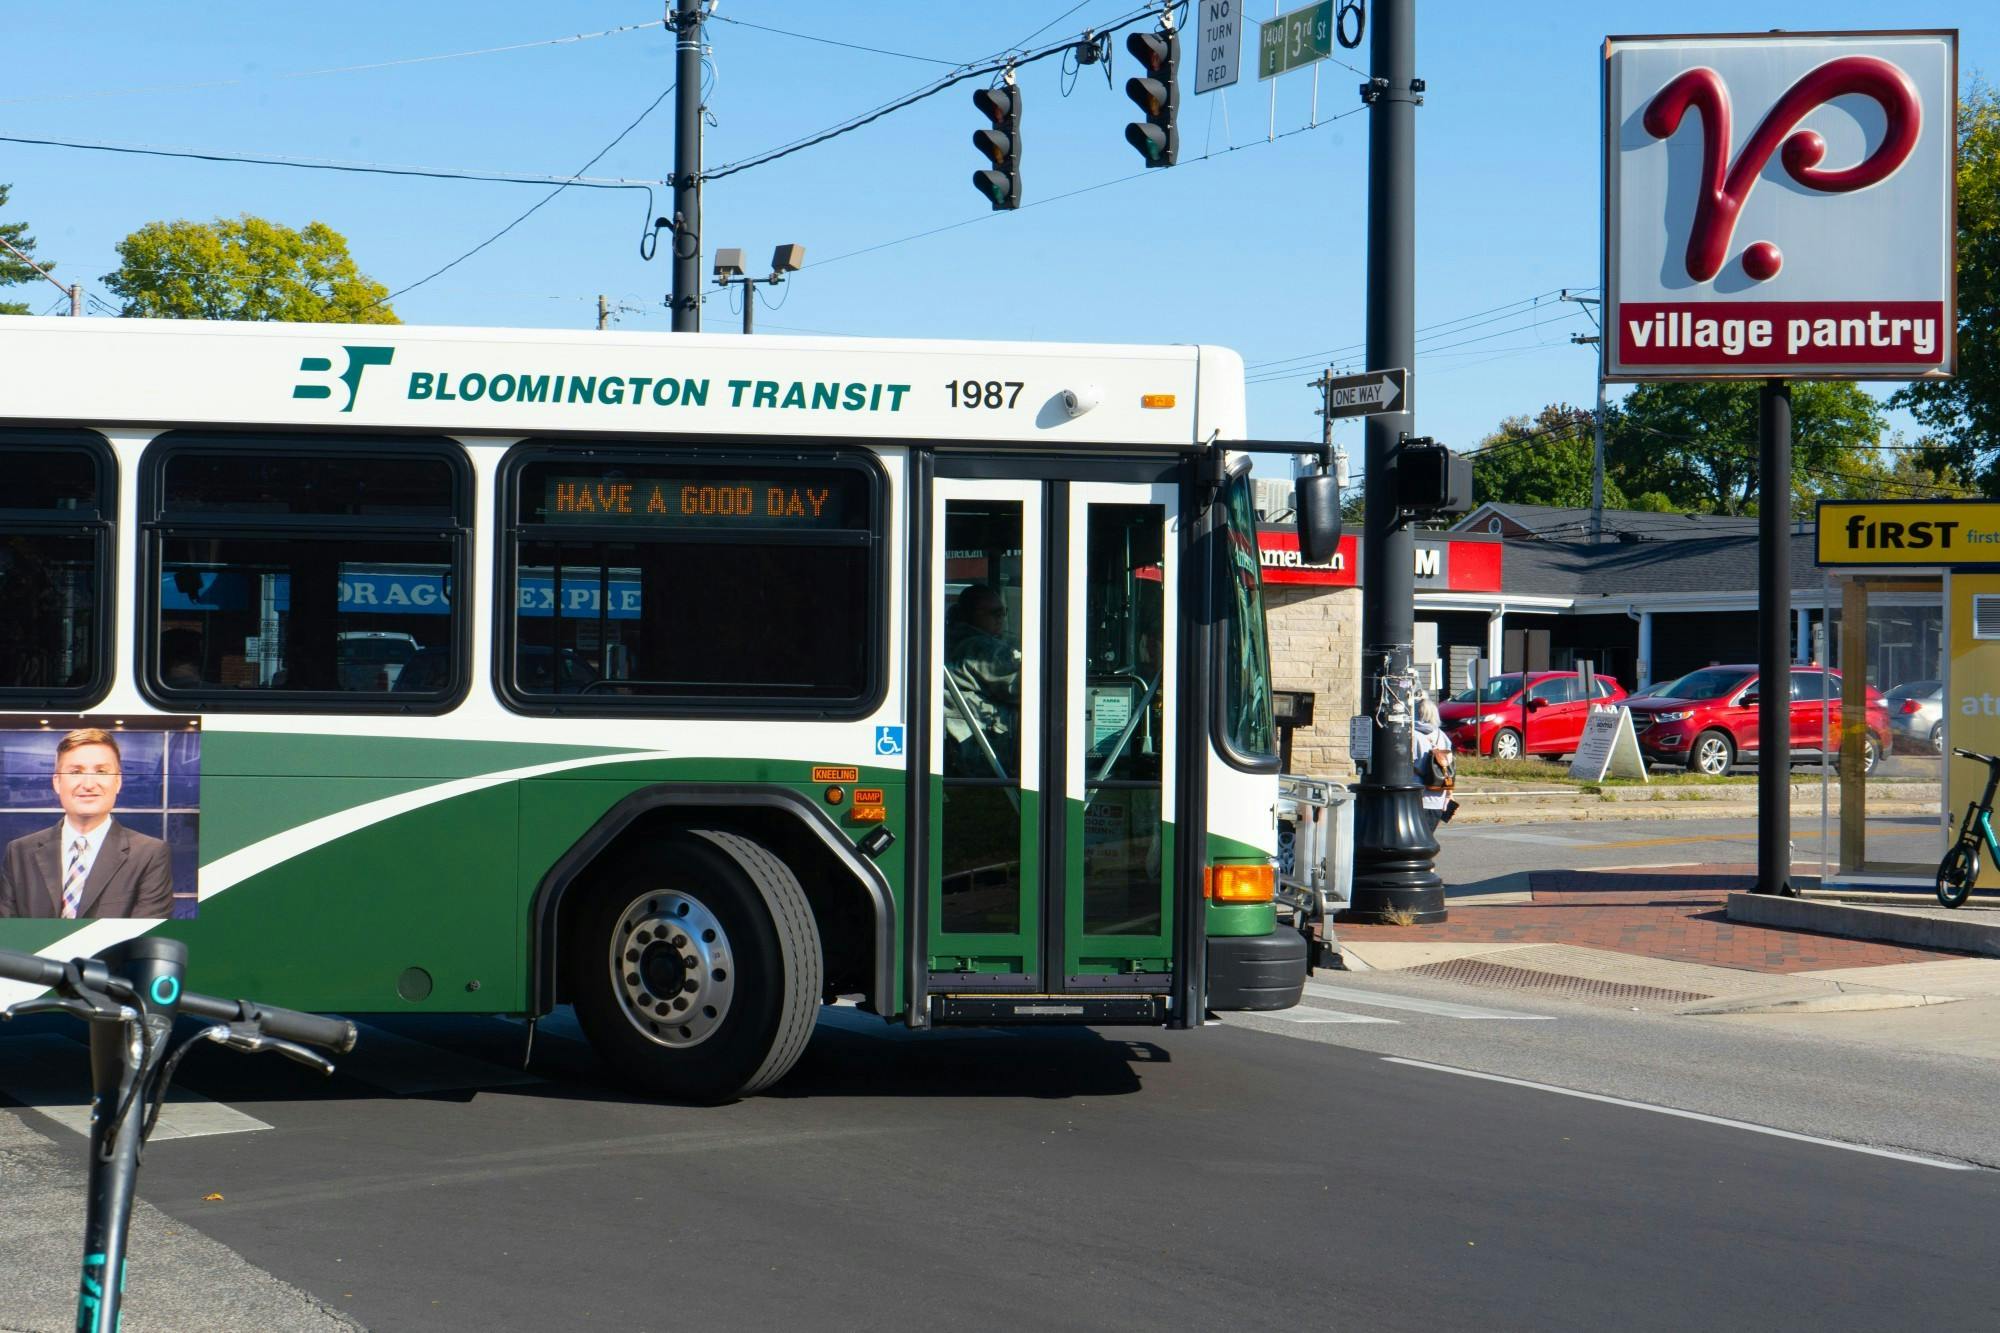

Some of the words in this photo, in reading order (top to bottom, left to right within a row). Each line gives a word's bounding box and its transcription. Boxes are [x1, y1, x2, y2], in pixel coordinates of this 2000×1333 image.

[1209, 2, 1230, 22] NO
[1206, 22, 1232, 42] TURN
[1263, 24, 1283, 46] 1400
[1292, 17, 1312, 57] 3rd
[1316, 20, 1327, 41] St
[1211, 44, 1225, 62] ON
[1269, 50, 1276, 69] E
[1207, 64, 1227, 83] RED
[1628, 311, 1773, 354] village
[1787, 310, 1936, 355] pantry
[407, 371, 710, 407] BLOOMINGTON
[727, 379, 911, 412] TRANSIT
[944, 379, 1025, 410] 1987
[1335, 388, 1356, 405] ONE
[1359, 385, 1382, 402] WAY
[556, 482, 633, 514] HAVE
[647, 485, 667, 514] A
[681, 485, 754, 516] GOOD
[767, 487, 829, 517] DAY
[816, 769, 855, 780] KNEELING
[857, 792, 880, 801] RAMP
